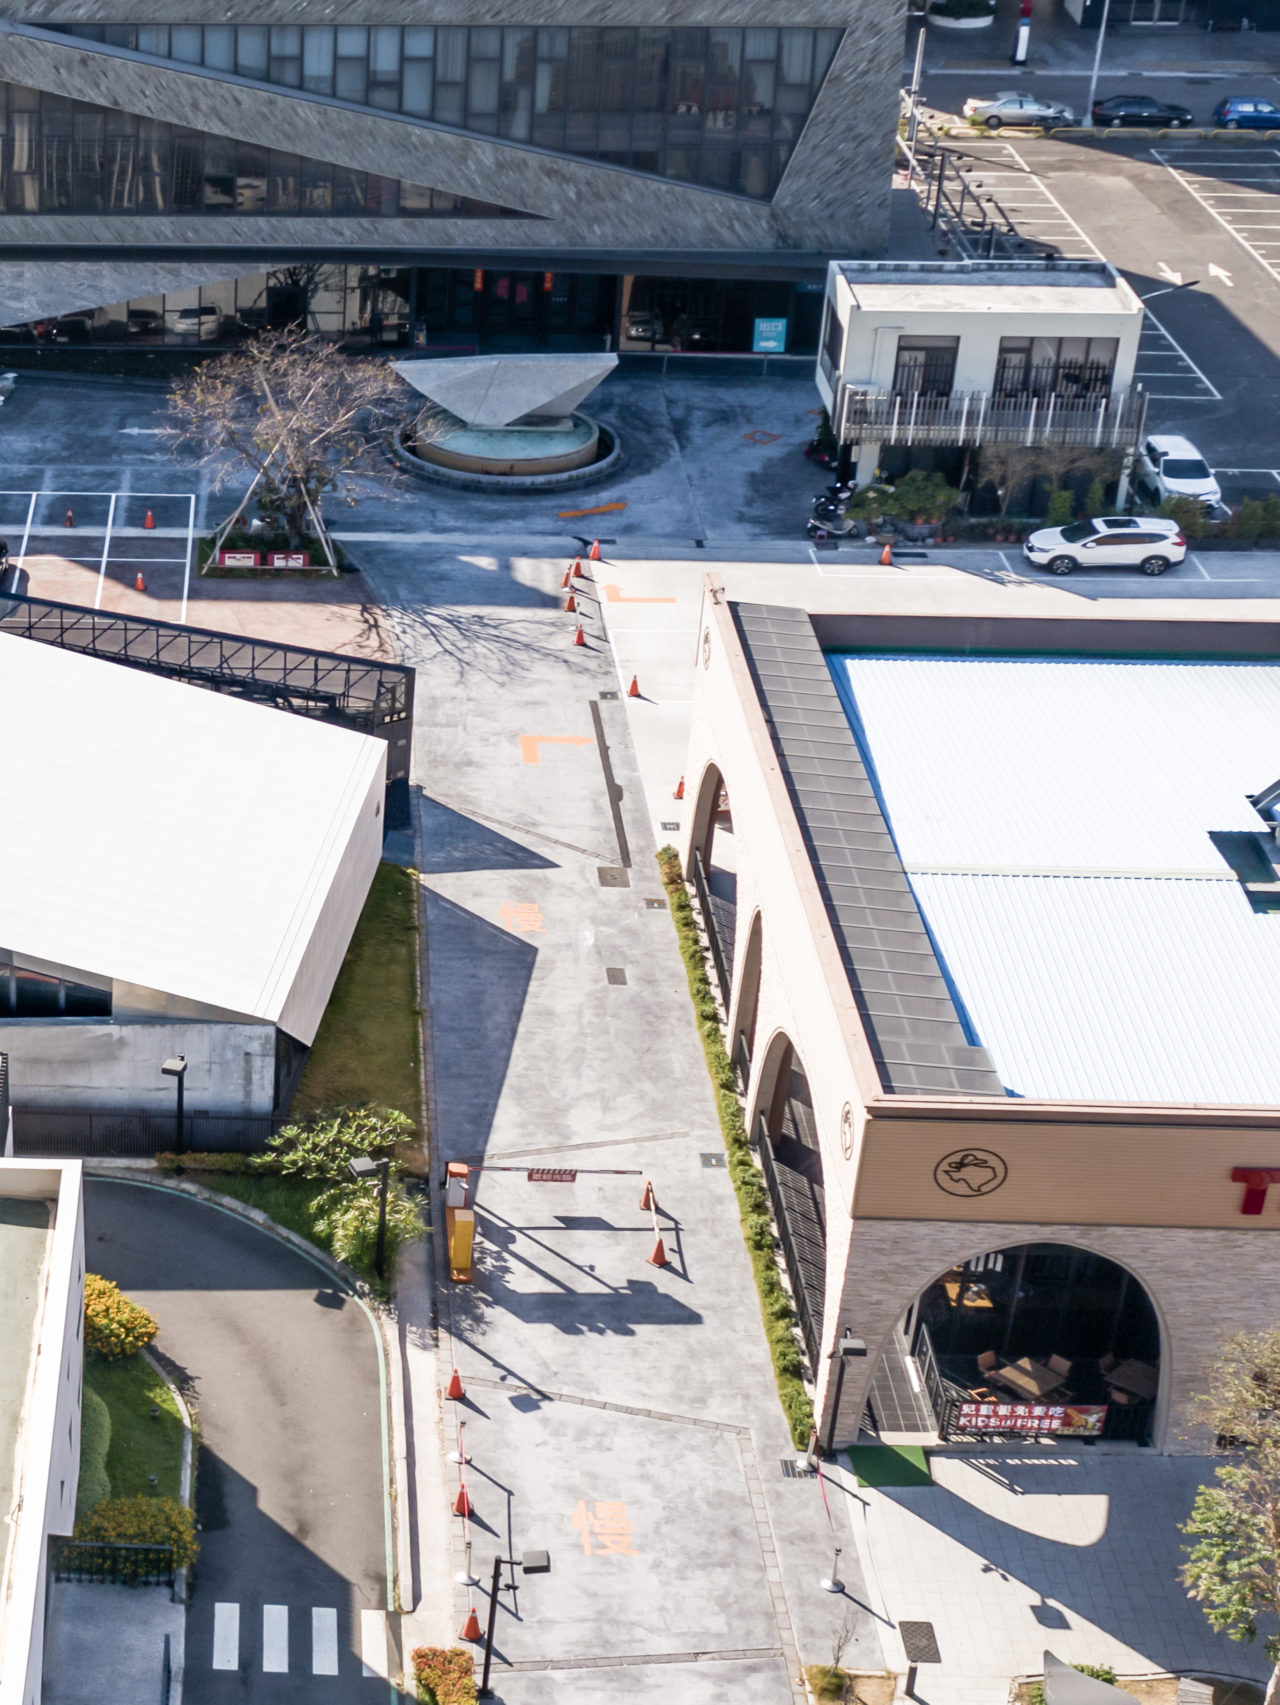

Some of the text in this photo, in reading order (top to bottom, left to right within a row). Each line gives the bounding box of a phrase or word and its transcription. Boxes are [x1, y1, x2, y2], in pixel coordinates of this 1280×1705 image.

[958, 1416, 1000, 1427] KIDS
[1016, 1417, 1062, 1428] FREE
[571, 1499, 640, 1556] 慢
